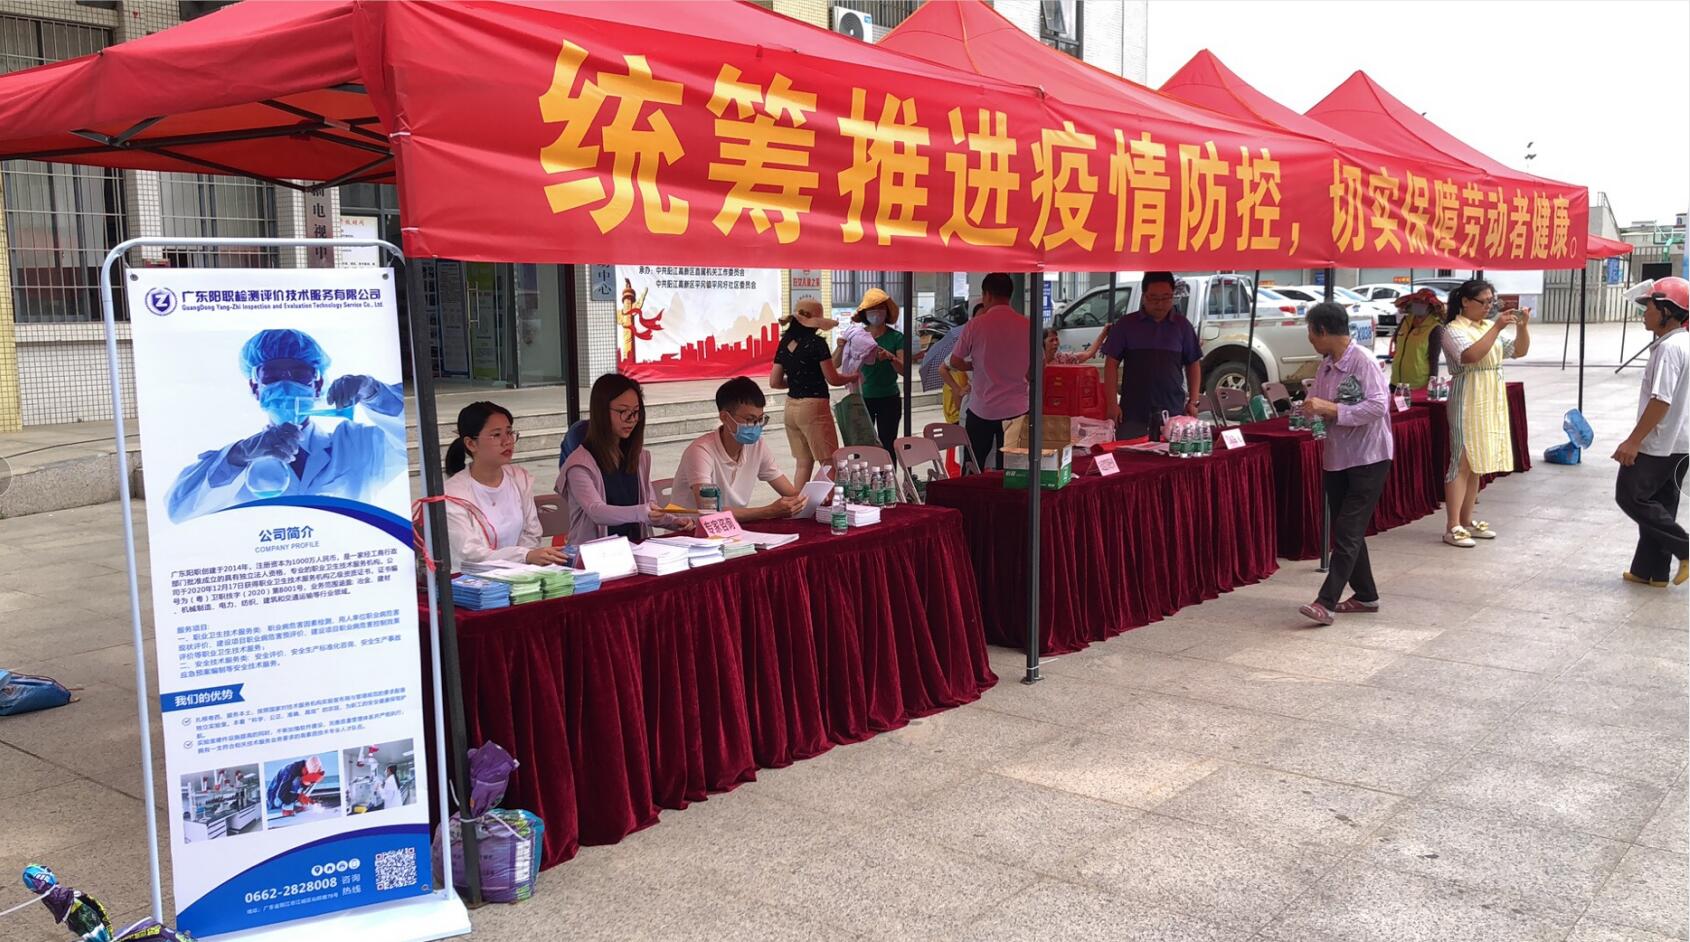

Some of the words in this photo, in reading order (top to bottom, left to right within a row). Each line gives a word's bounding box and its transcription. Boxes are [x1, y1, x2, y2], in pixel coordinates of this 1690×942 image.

[182, 288, 382, 303] 广东阳职检测评价技术服务有限公司
[258, 525, 315, 543] 公司简介
[254, 545, 290, 554] COMPANY
[290, 541, 320, 550] PROFILE
[174, 689, 234, 707] 我们的优势
[341, 873, 361, 885] 咨询
[244, 876, 337, 904] 0662-2828008
[342, 885, 362, 897] 热线
